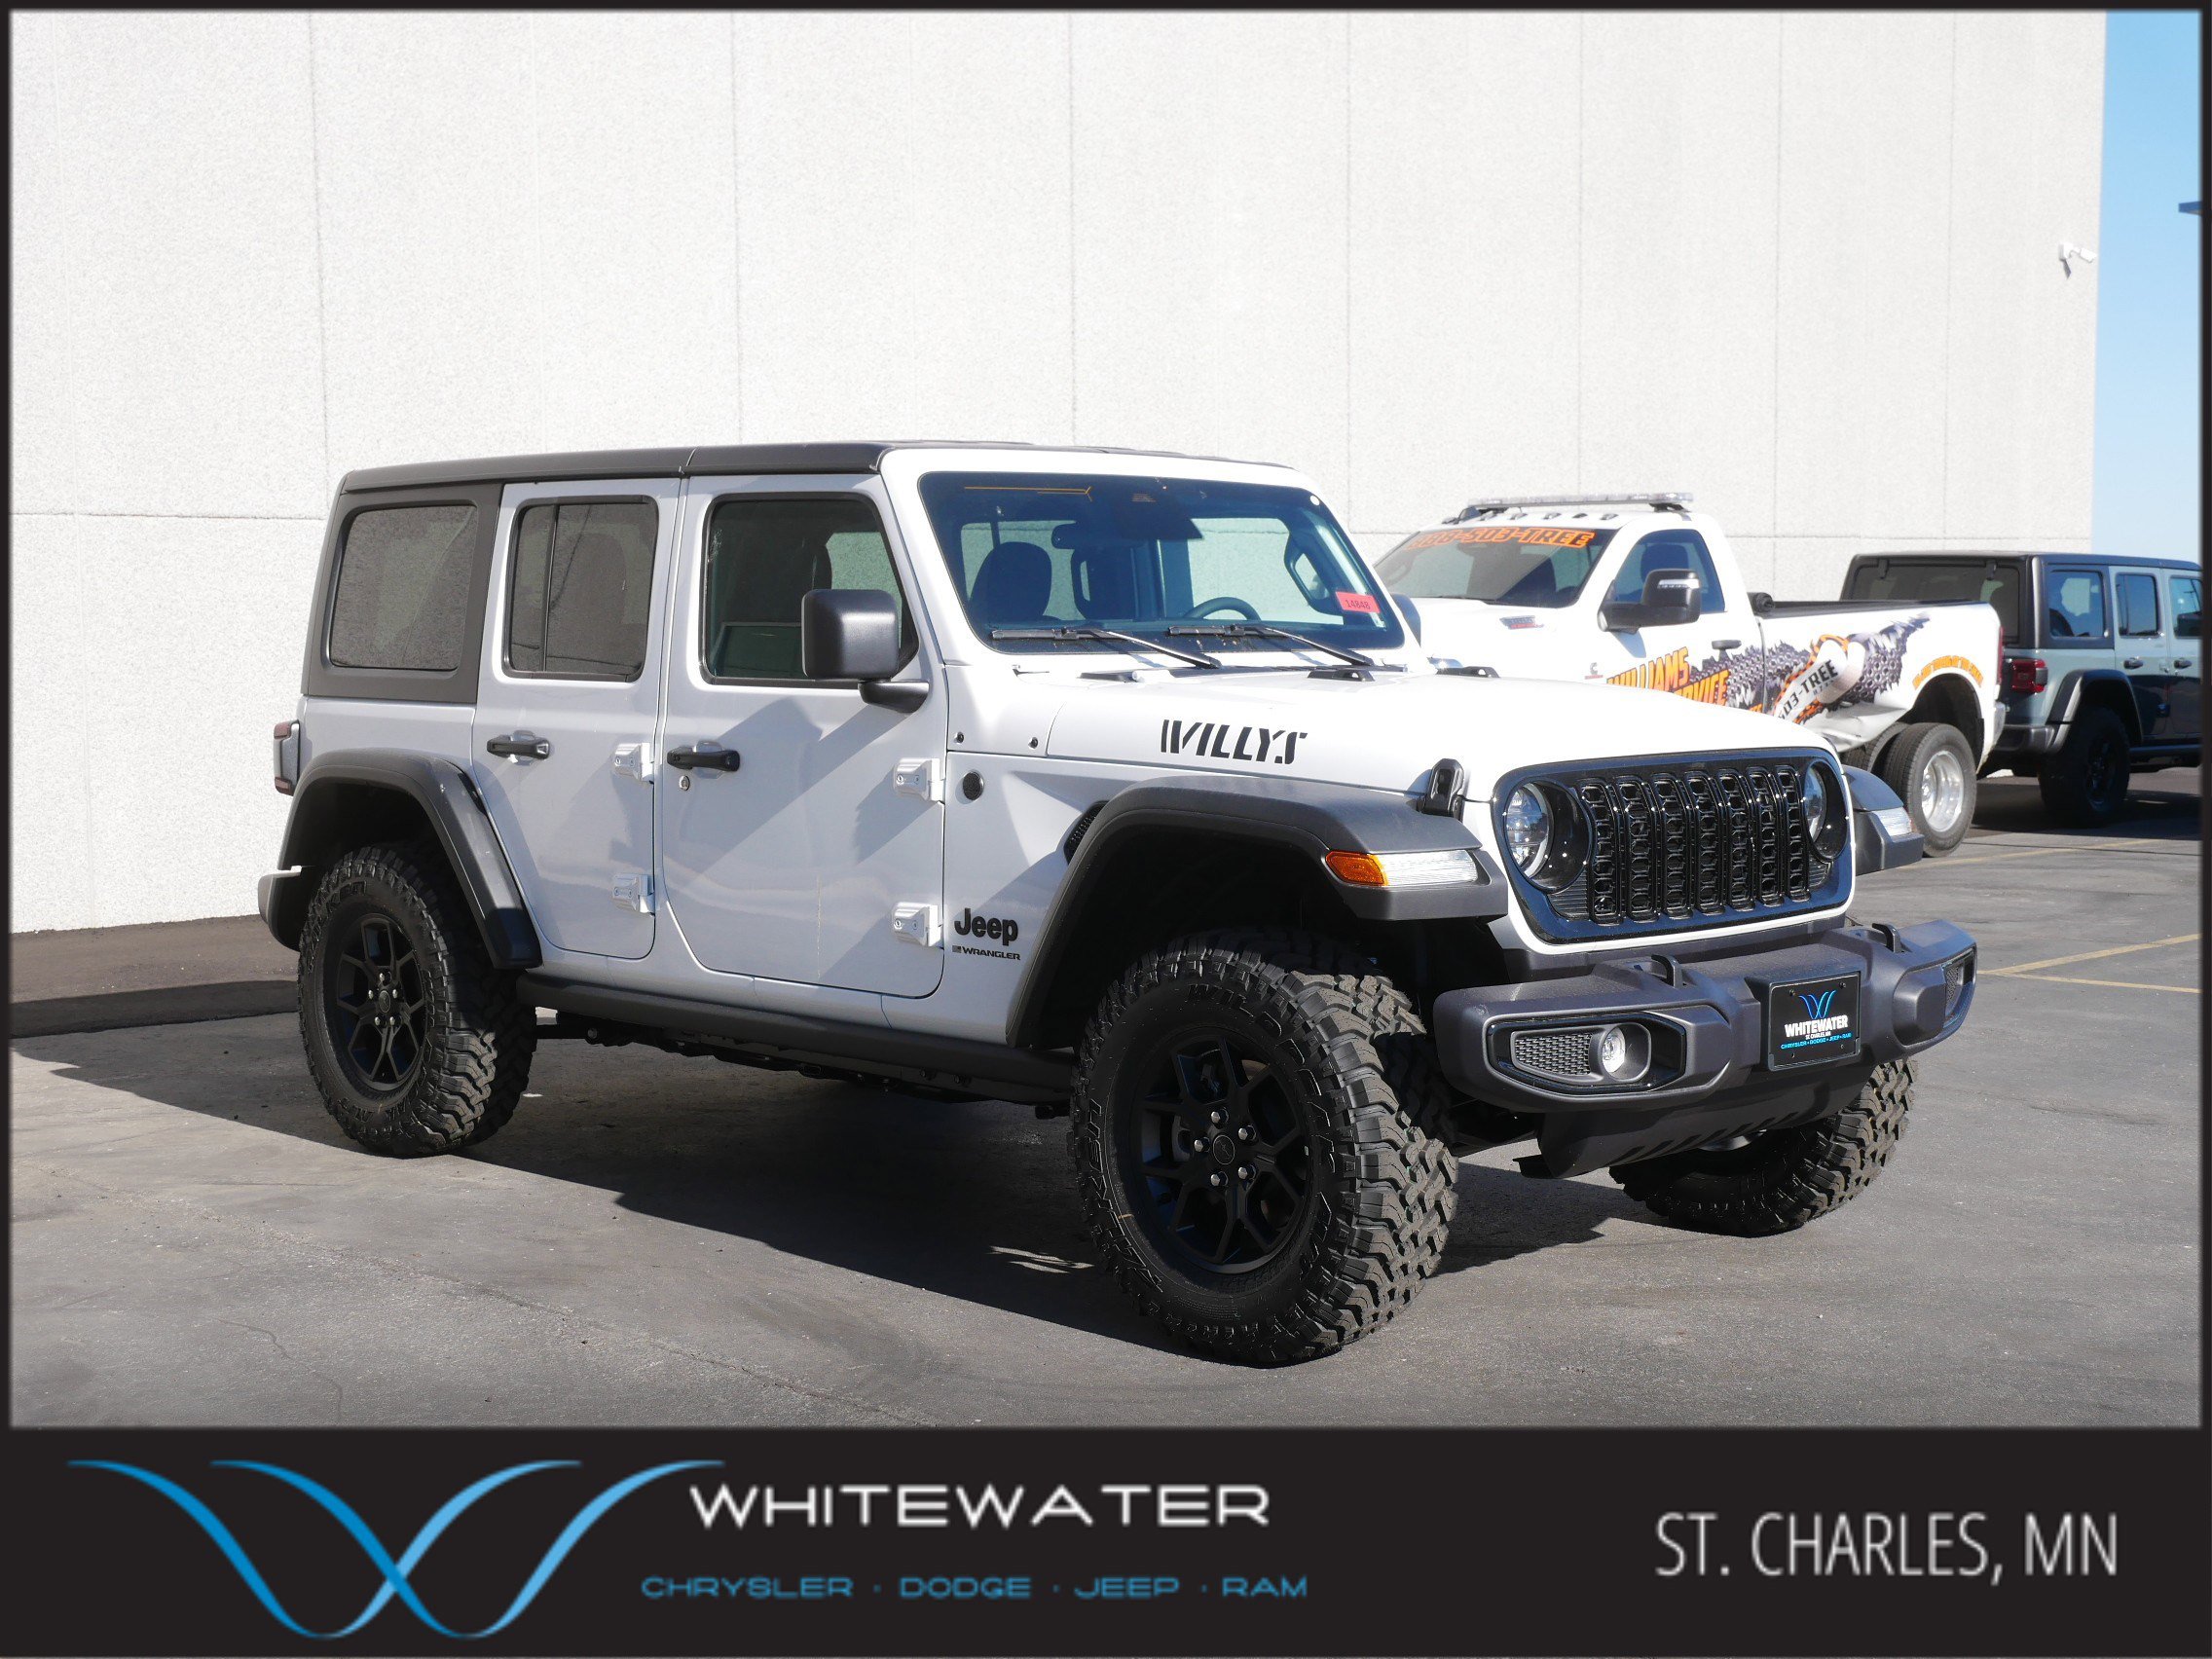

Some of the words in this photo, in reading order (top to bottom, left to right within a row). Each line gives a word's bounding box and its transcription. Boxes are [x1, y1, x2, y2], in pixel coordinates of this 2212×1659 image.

[1161, 719, 1309, 765] WILLYS
[953, 907, 1019, 947] Jeep
[962, 946, 1021, 961] WRANGLER
[1785, 1014, 1849, 1038] WHITEWATER
